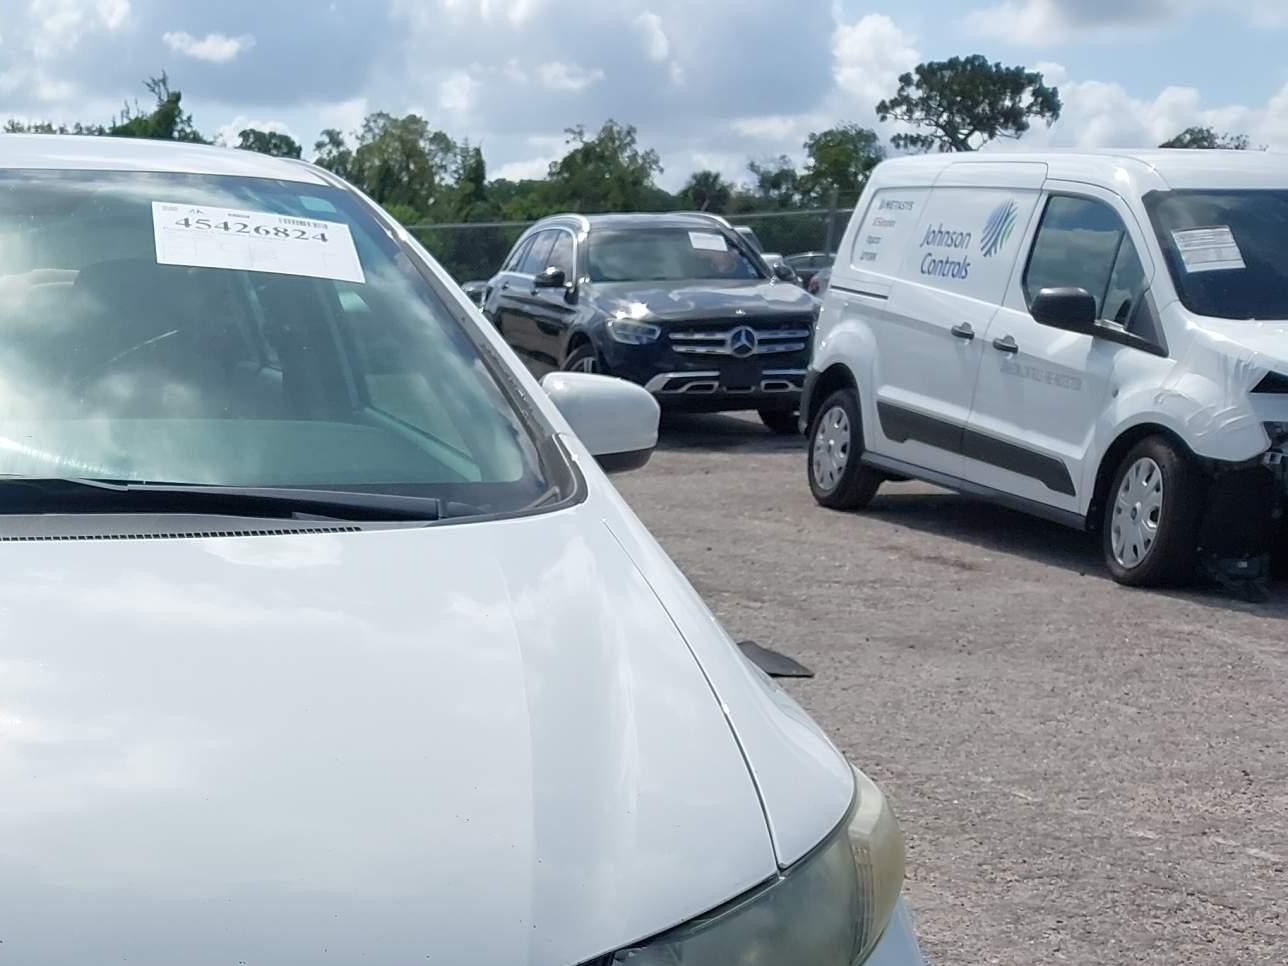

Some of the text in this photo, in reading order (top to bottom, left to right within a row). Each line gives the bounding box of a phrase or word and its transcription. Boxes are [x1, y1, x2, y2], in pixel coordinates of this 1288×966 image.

[175, 217, 328, 243] 45426824
[919, 223, 971, 249] Johnson
[920, 252, 970, 279] Controls
